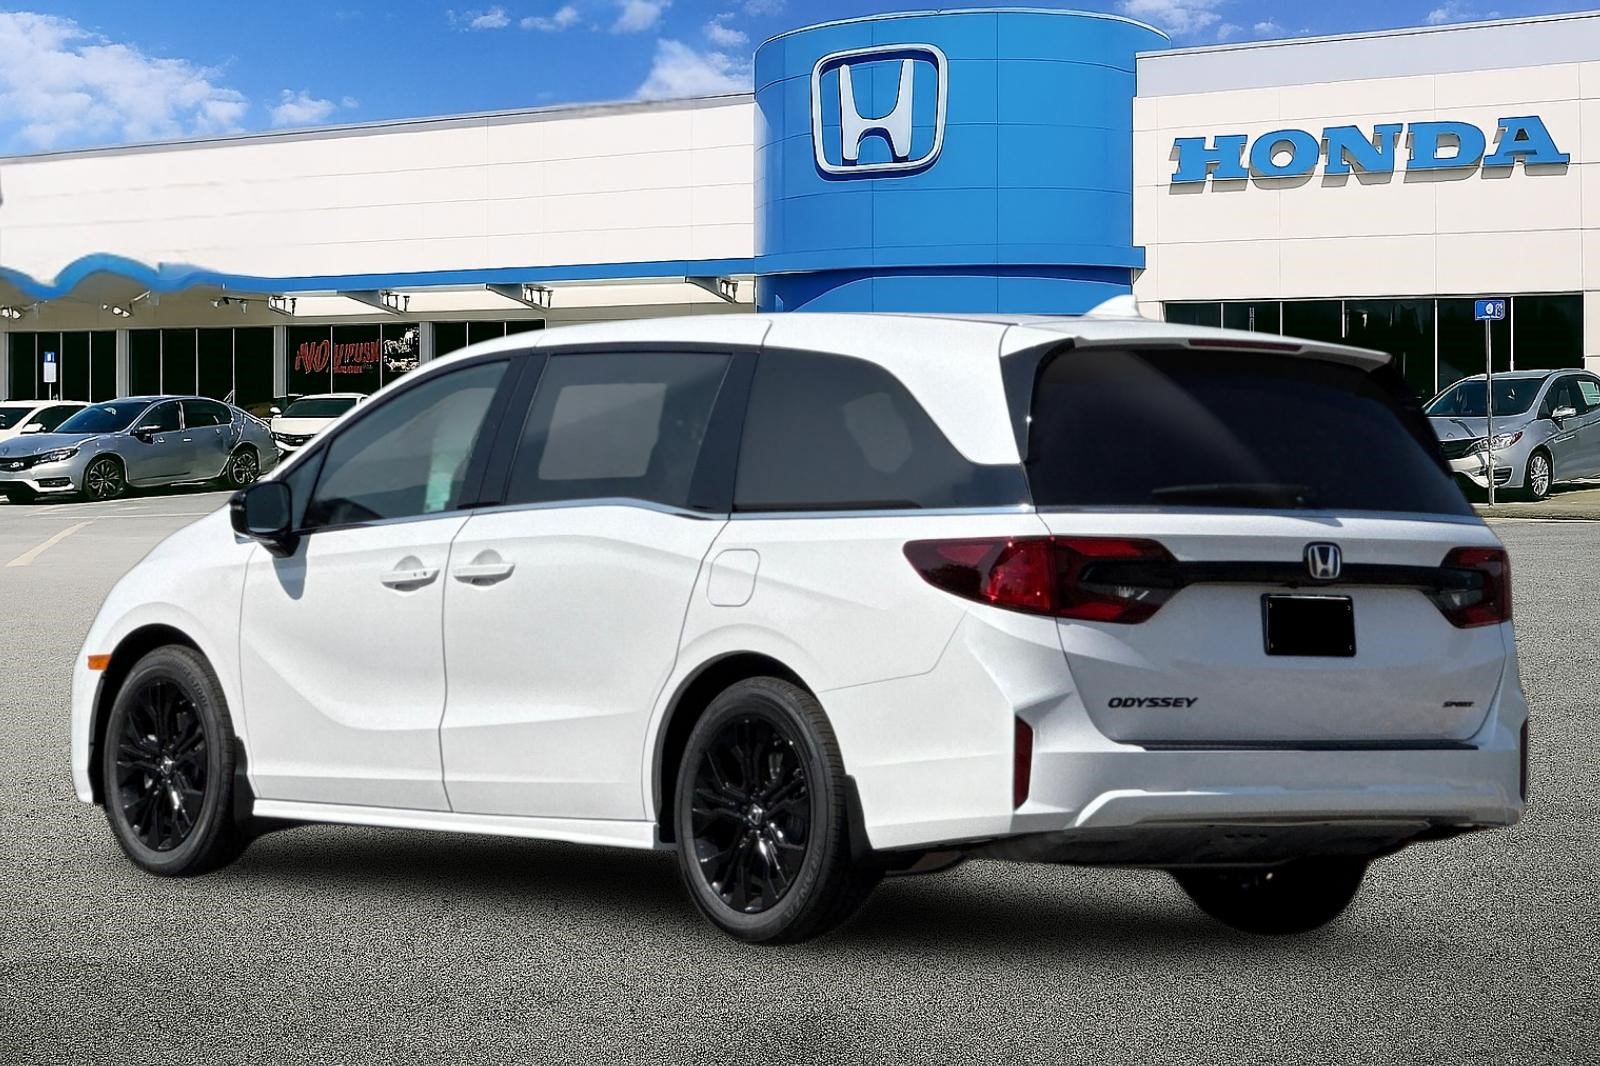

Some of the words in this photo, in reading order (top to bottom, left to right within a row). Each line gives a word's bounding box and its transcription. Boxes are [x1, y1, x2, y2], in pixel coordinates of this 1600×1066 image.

[1171, 115, 1570, 183] HONDA
[295, 340, 330, 374] NO
[1107, 696, 1199, 709] ODYSSEY
